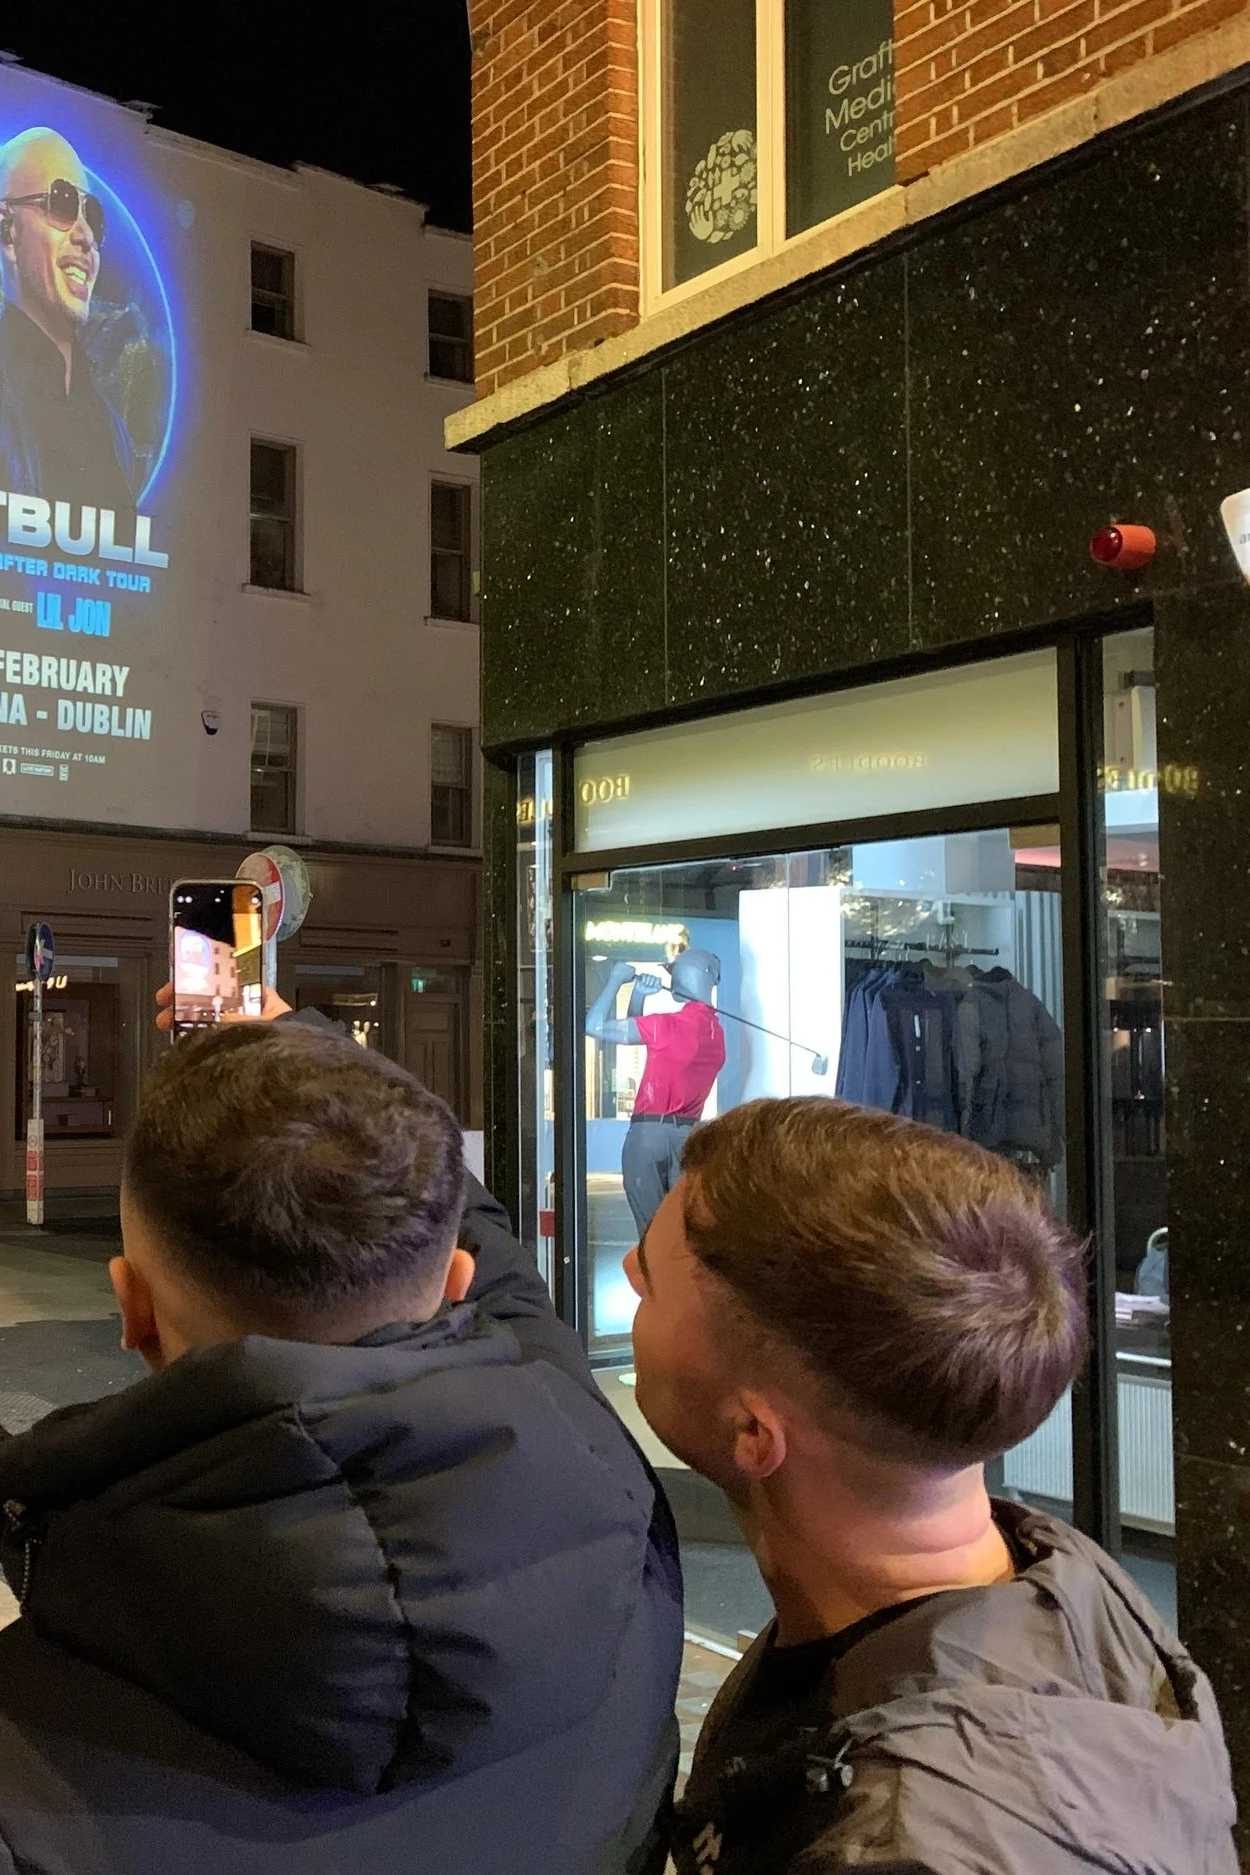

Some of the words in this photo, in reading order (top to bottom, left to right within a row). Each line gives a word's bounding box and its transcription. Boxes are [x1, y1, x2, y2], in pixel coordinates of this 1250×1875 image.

[829, 38, 895, 94] Graft
[825, 75, 896, 134] Medi
[53, 561, 100, 586] DARK
[106, 570, 151, 593] TOUR
[11, 600, 34, 614] GUEST
[36, 591, 64, 631] LIL
[68, 597, 111, 637] JON
[57, 699, 152, 740] DUBLIN
[20, 747, 39, 757] THIS
[41, 749, 71, 760] FRIDAY
[72, 752, 82, 761] AT
[84, 754, 106, 764] 10AM
[66, 868, 124, 895] JOHN
